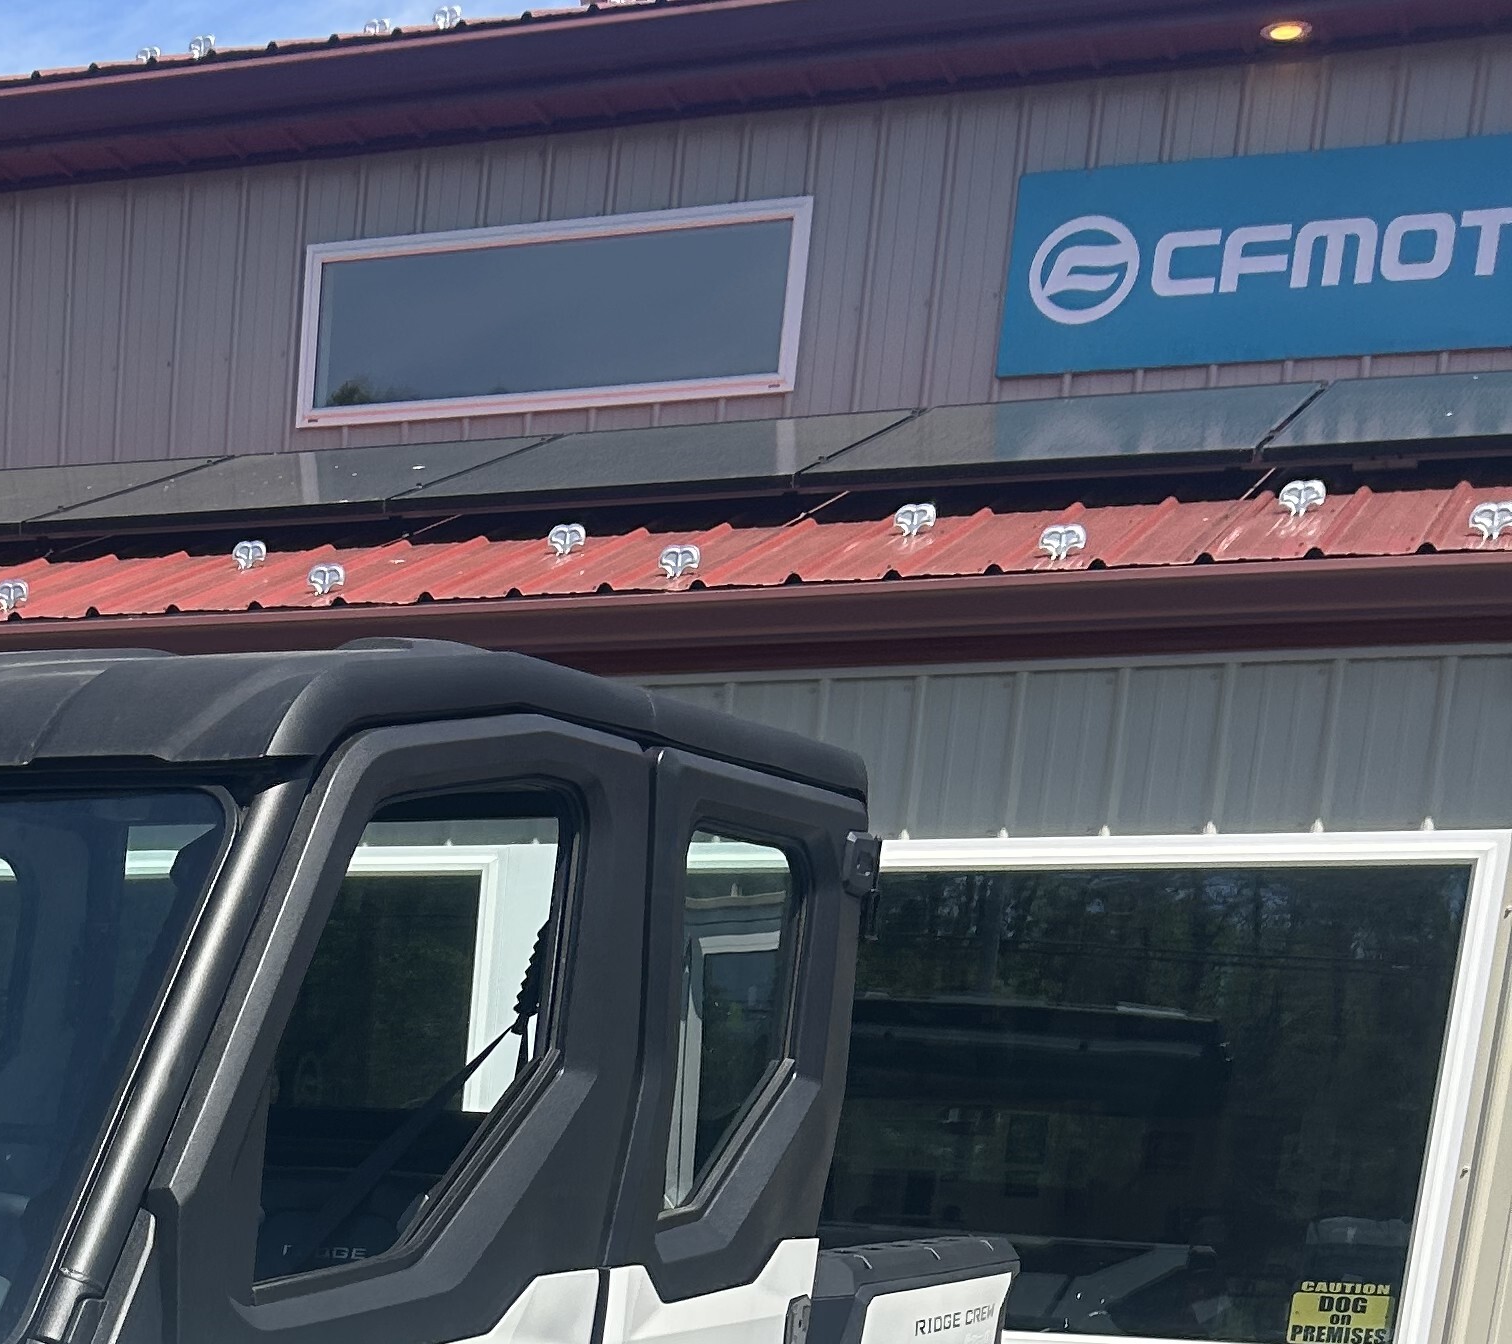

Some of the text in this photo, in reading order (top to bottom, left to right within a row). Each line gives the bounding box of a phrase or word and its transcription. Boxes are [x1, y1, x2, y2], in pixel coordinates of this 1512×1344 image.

[1301, 1281, 1391, 1295] CAUTION
[1318, 1295, 1368, 1314] DOG
[915, 1303, 996, 1336] RIDGE CREW
[1329, 1314, 1352, 1326] on
